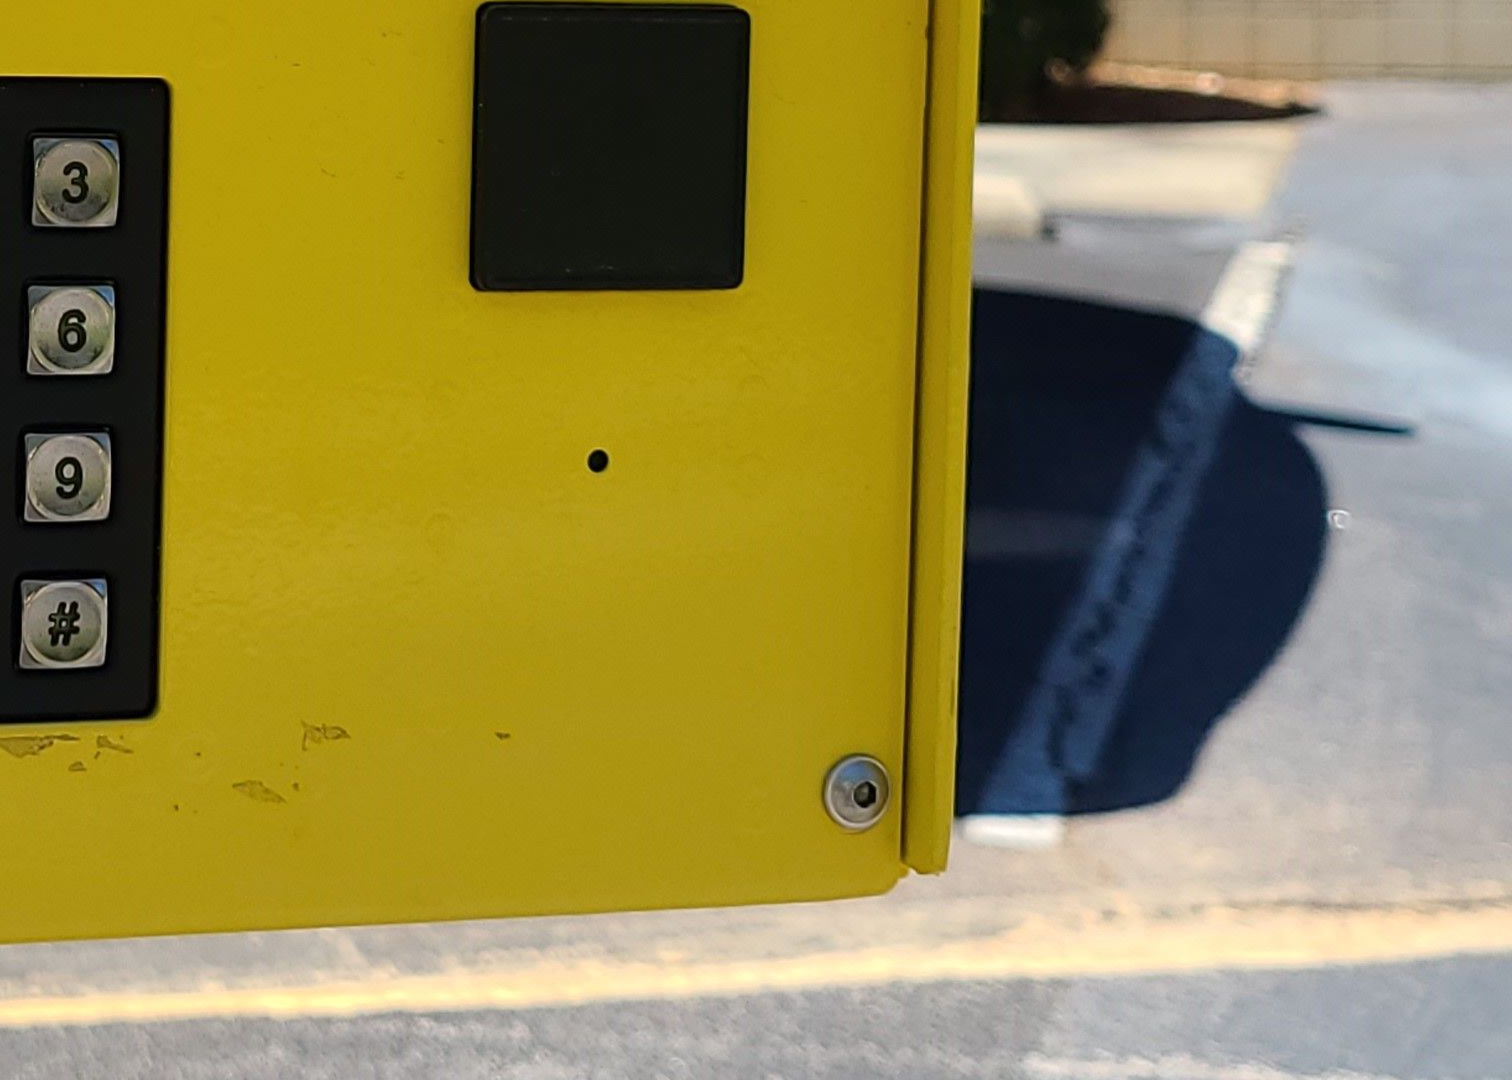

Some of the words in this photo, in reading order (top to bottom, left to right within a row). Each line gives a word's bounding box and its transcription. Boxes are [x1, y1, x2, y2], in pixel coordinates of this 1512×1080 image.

[61, 161, 89, 204] 3
[57, 309, 87, 353] 6
[54, 456, 84, 500] 9
[48, 601, 81, 647] #
